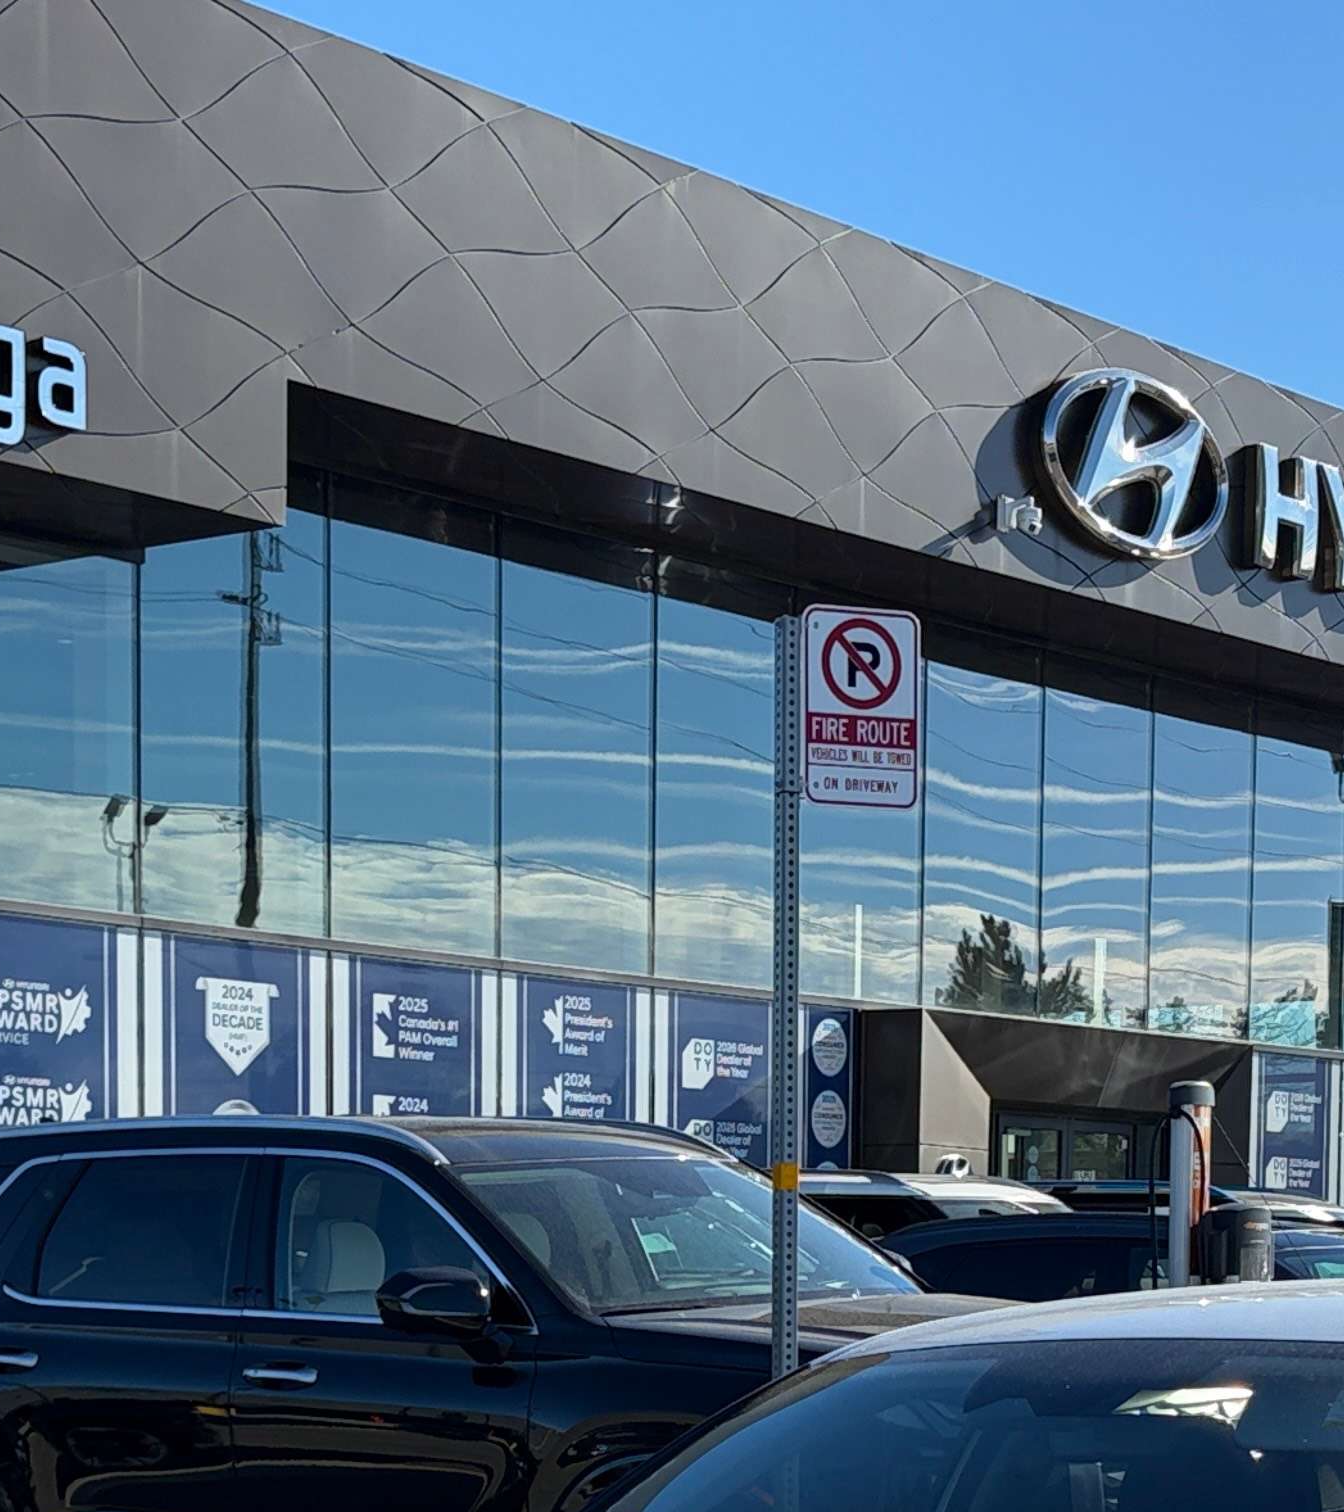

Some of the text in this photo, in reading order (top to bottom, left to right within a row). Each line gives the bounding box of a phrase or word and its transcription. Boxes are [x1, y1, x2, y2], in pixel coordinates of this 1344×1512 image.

[811, 716, 911, 746] FIRE ROUTE
[811, 747, 912, 766] VEHICLES WILL BE TOWED
[823, 777, 898, 794] ON DRIVEWAY
[222, 984, 253, 1001] 2024
[398, 996, 428, 1013] 2025
[564, 995, 591, 1011] 2025
[212, 1013, 263, 1031] DECADE
[398, 1014, 445, 1031] Canada's
[398, 1046, 435, 1062] Winner
[564, 1072, 591, 1088] 2024
[398, 1096, 429, 1113] 2024
